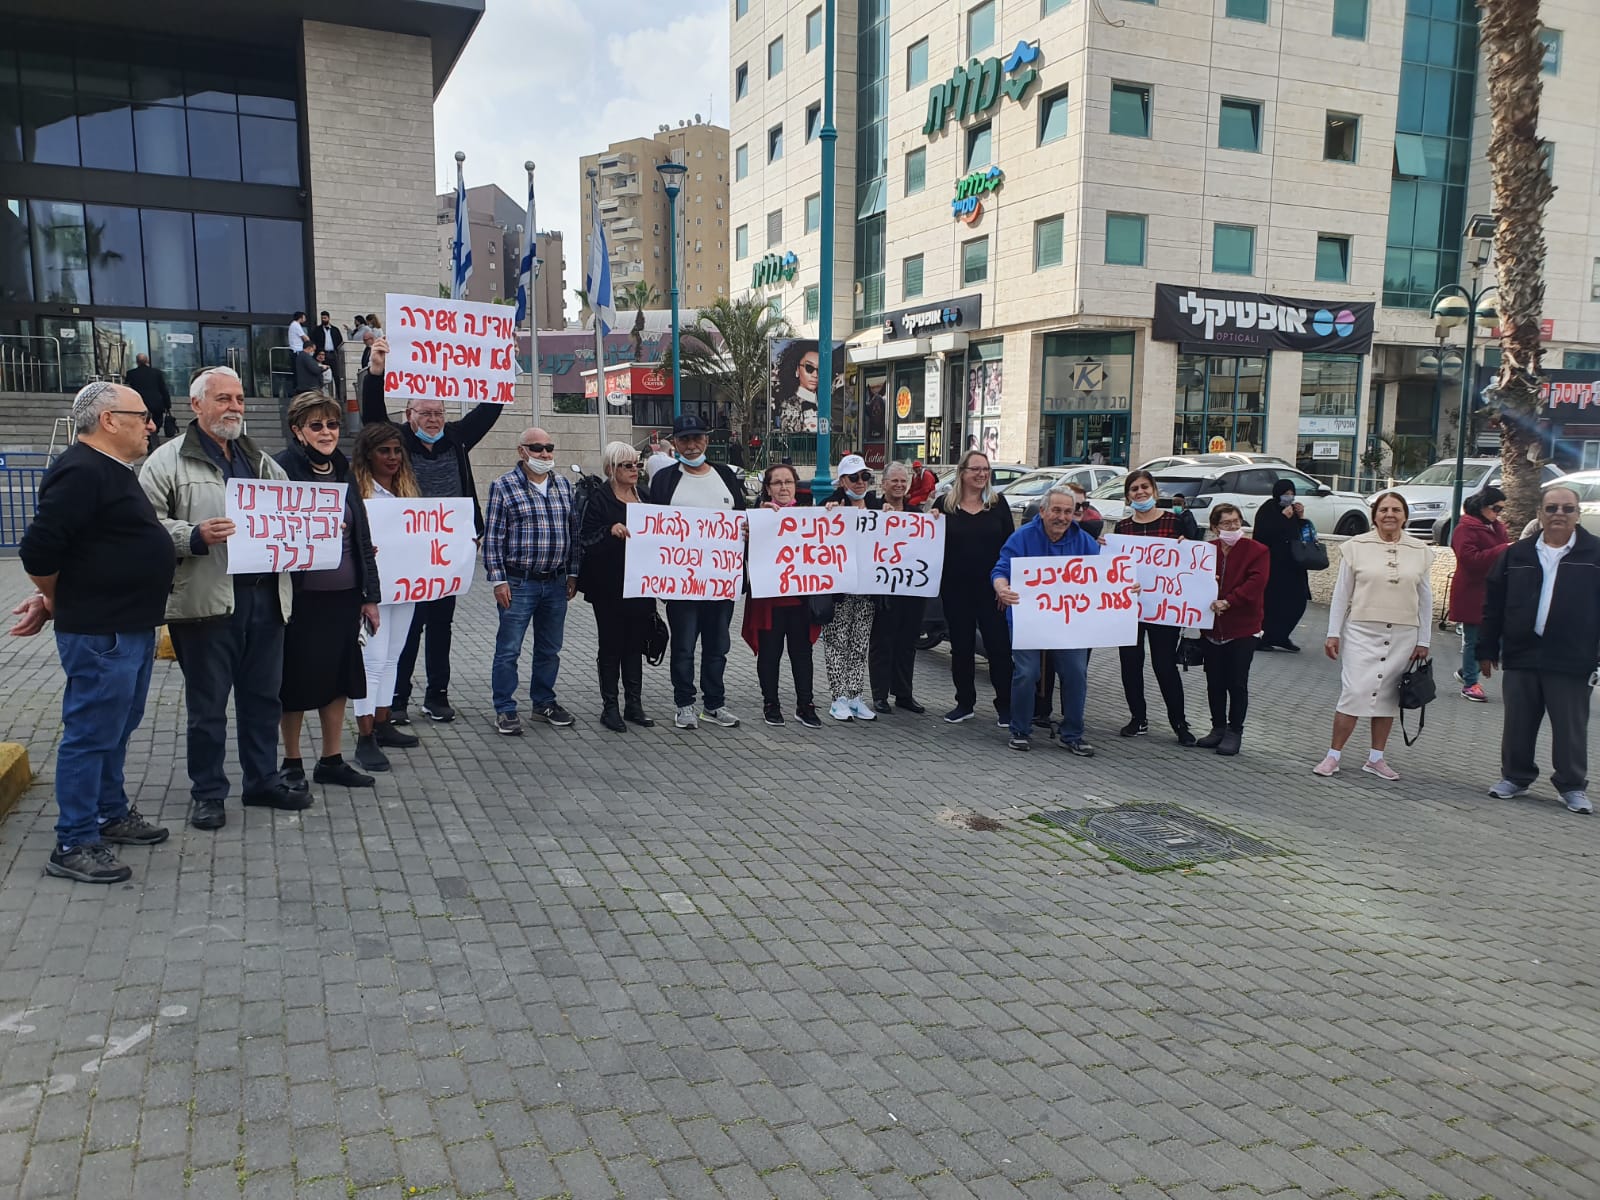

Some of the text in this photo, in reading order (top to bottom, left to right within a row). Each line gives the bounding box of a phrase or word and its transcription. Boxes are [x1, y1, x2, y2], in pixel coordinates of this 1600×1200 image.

[922, 56, 1001, 135] כללית
[955, 172, 986, 200] כללית
[751, 253, 782, 289] כללית
[400, 305, 513, 340] מדינה עשירה
[902, 309, 942, 335] אופטיקלי
[1179, 291, 1307, 340] אופטיקלי
[1216, 332, 1260, 343] OPTICALI
[490, 343, 514, 370] לא
[486, 381, 514, 404] את
[1549, 382, 1593, 409] קיוסק
[696, 511, 745, 541] להצמיד
[777, 513, 846, 544] זקנים
[885, 513, 936, 540] רוצים
[266, 541, 314, 573] נלך
[431, 538, 451, 566] או
[659, 546, 703, 568] ופנסיה
[775, 542, 847, 573] קופאים
[873, 541, 908, 565] לא
[1190, 544, 1214, 571] אל
[779, 564, 834, 593] בחורף
[875, 559, 929, 592] צדקה
[1023, 555, 1134, 587] אל תשליכני
[1143, 571, 1194, 597] לעת
[393, 576, 461, 602] תרופה
[1096, 586, 1134, 610] לעת
